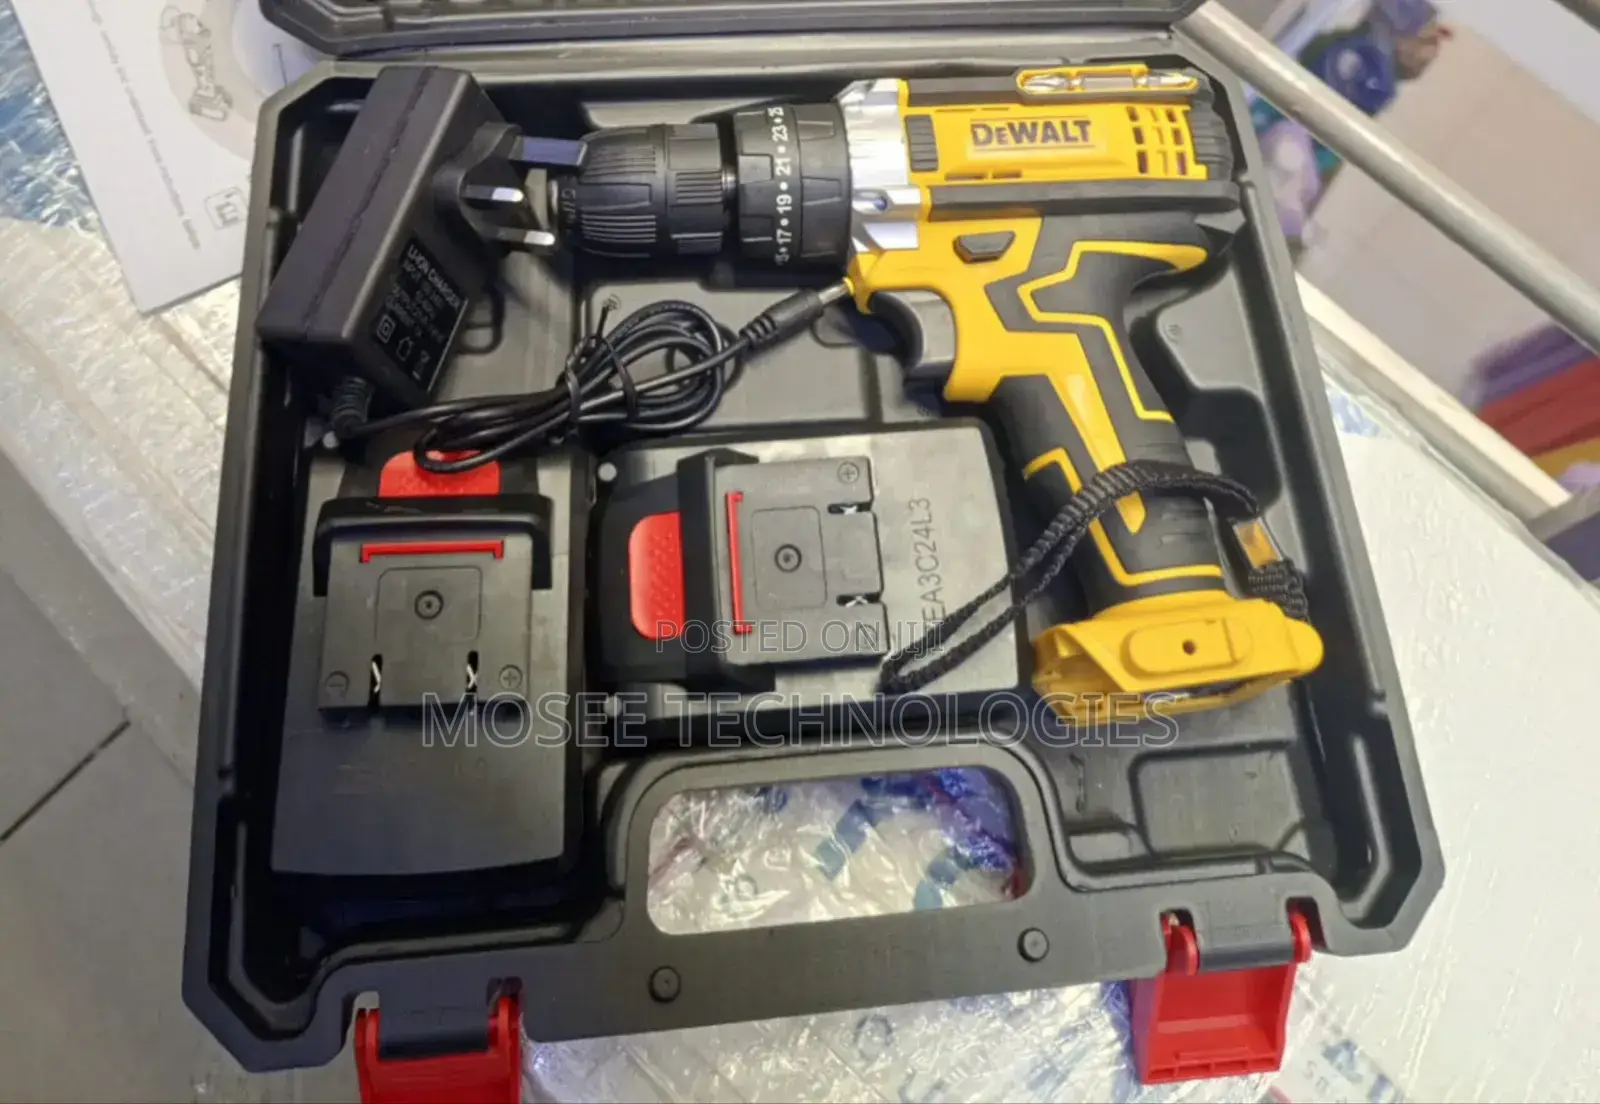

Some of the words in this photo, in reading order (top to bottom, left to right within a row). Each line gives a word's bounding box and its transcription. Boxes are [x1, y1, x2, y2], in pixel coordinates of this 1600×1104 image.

[772, 125, 788, 141] 23
[775, 157, 791, 176] 21
[776, 194, 792, 214] 19
[776, 228, 792, 245] 17
[908, 496, 947, 631] EA3C24L3
